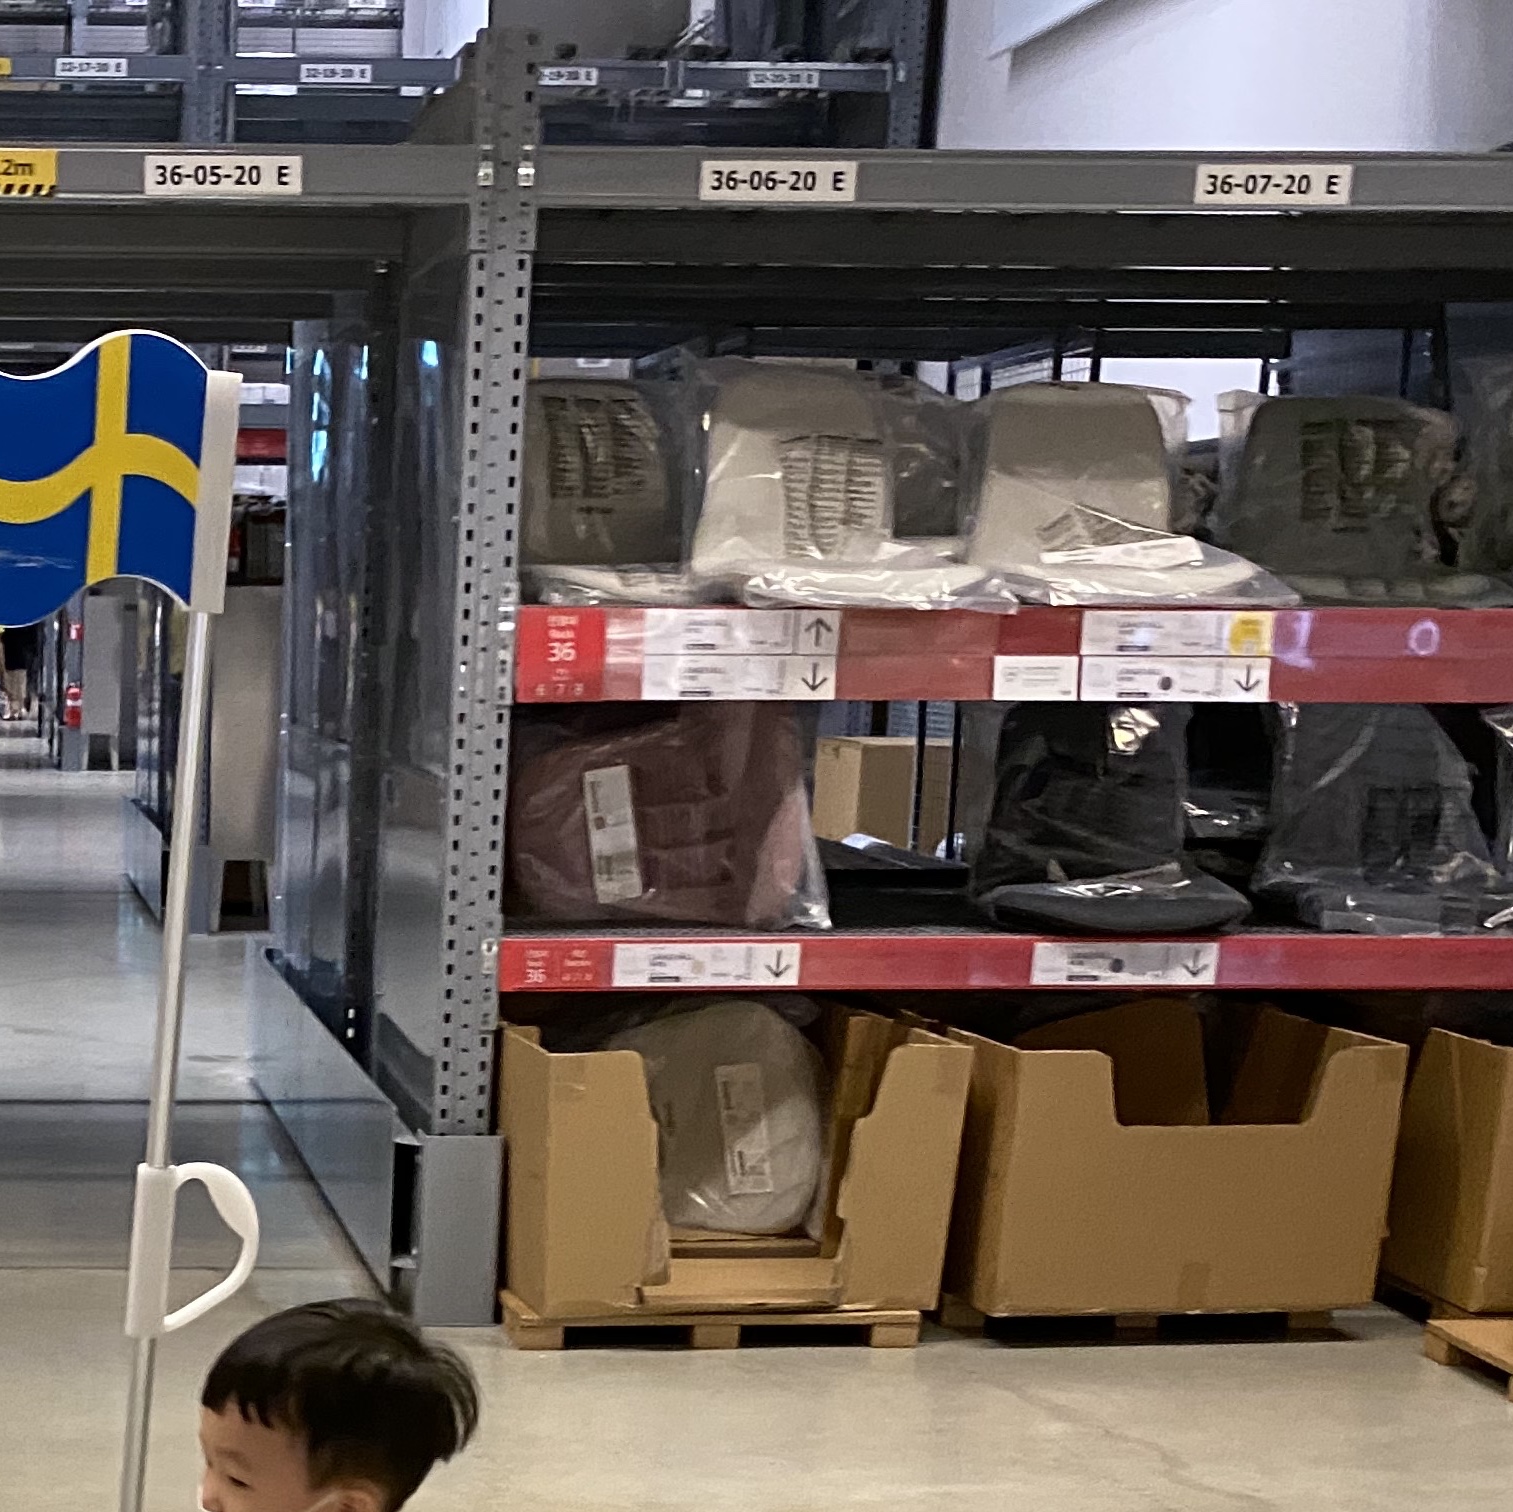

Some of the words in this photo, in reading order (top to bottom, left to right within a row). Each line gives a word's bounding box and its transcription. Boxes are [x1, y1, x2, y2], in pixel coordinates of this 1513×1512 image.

[155, 164, 262, 186] 36-05-20
[277, 165, 290, 186] E
[711, 170, 817, 192] 36-06-20
[832, 171, 846, 192] E
[1205, 174, 1312, 195] 36-07-20
[1326, 174, 1341, 195] E
[548, 642, 577, 662] 36
[525, 969, 546, 983] 36
